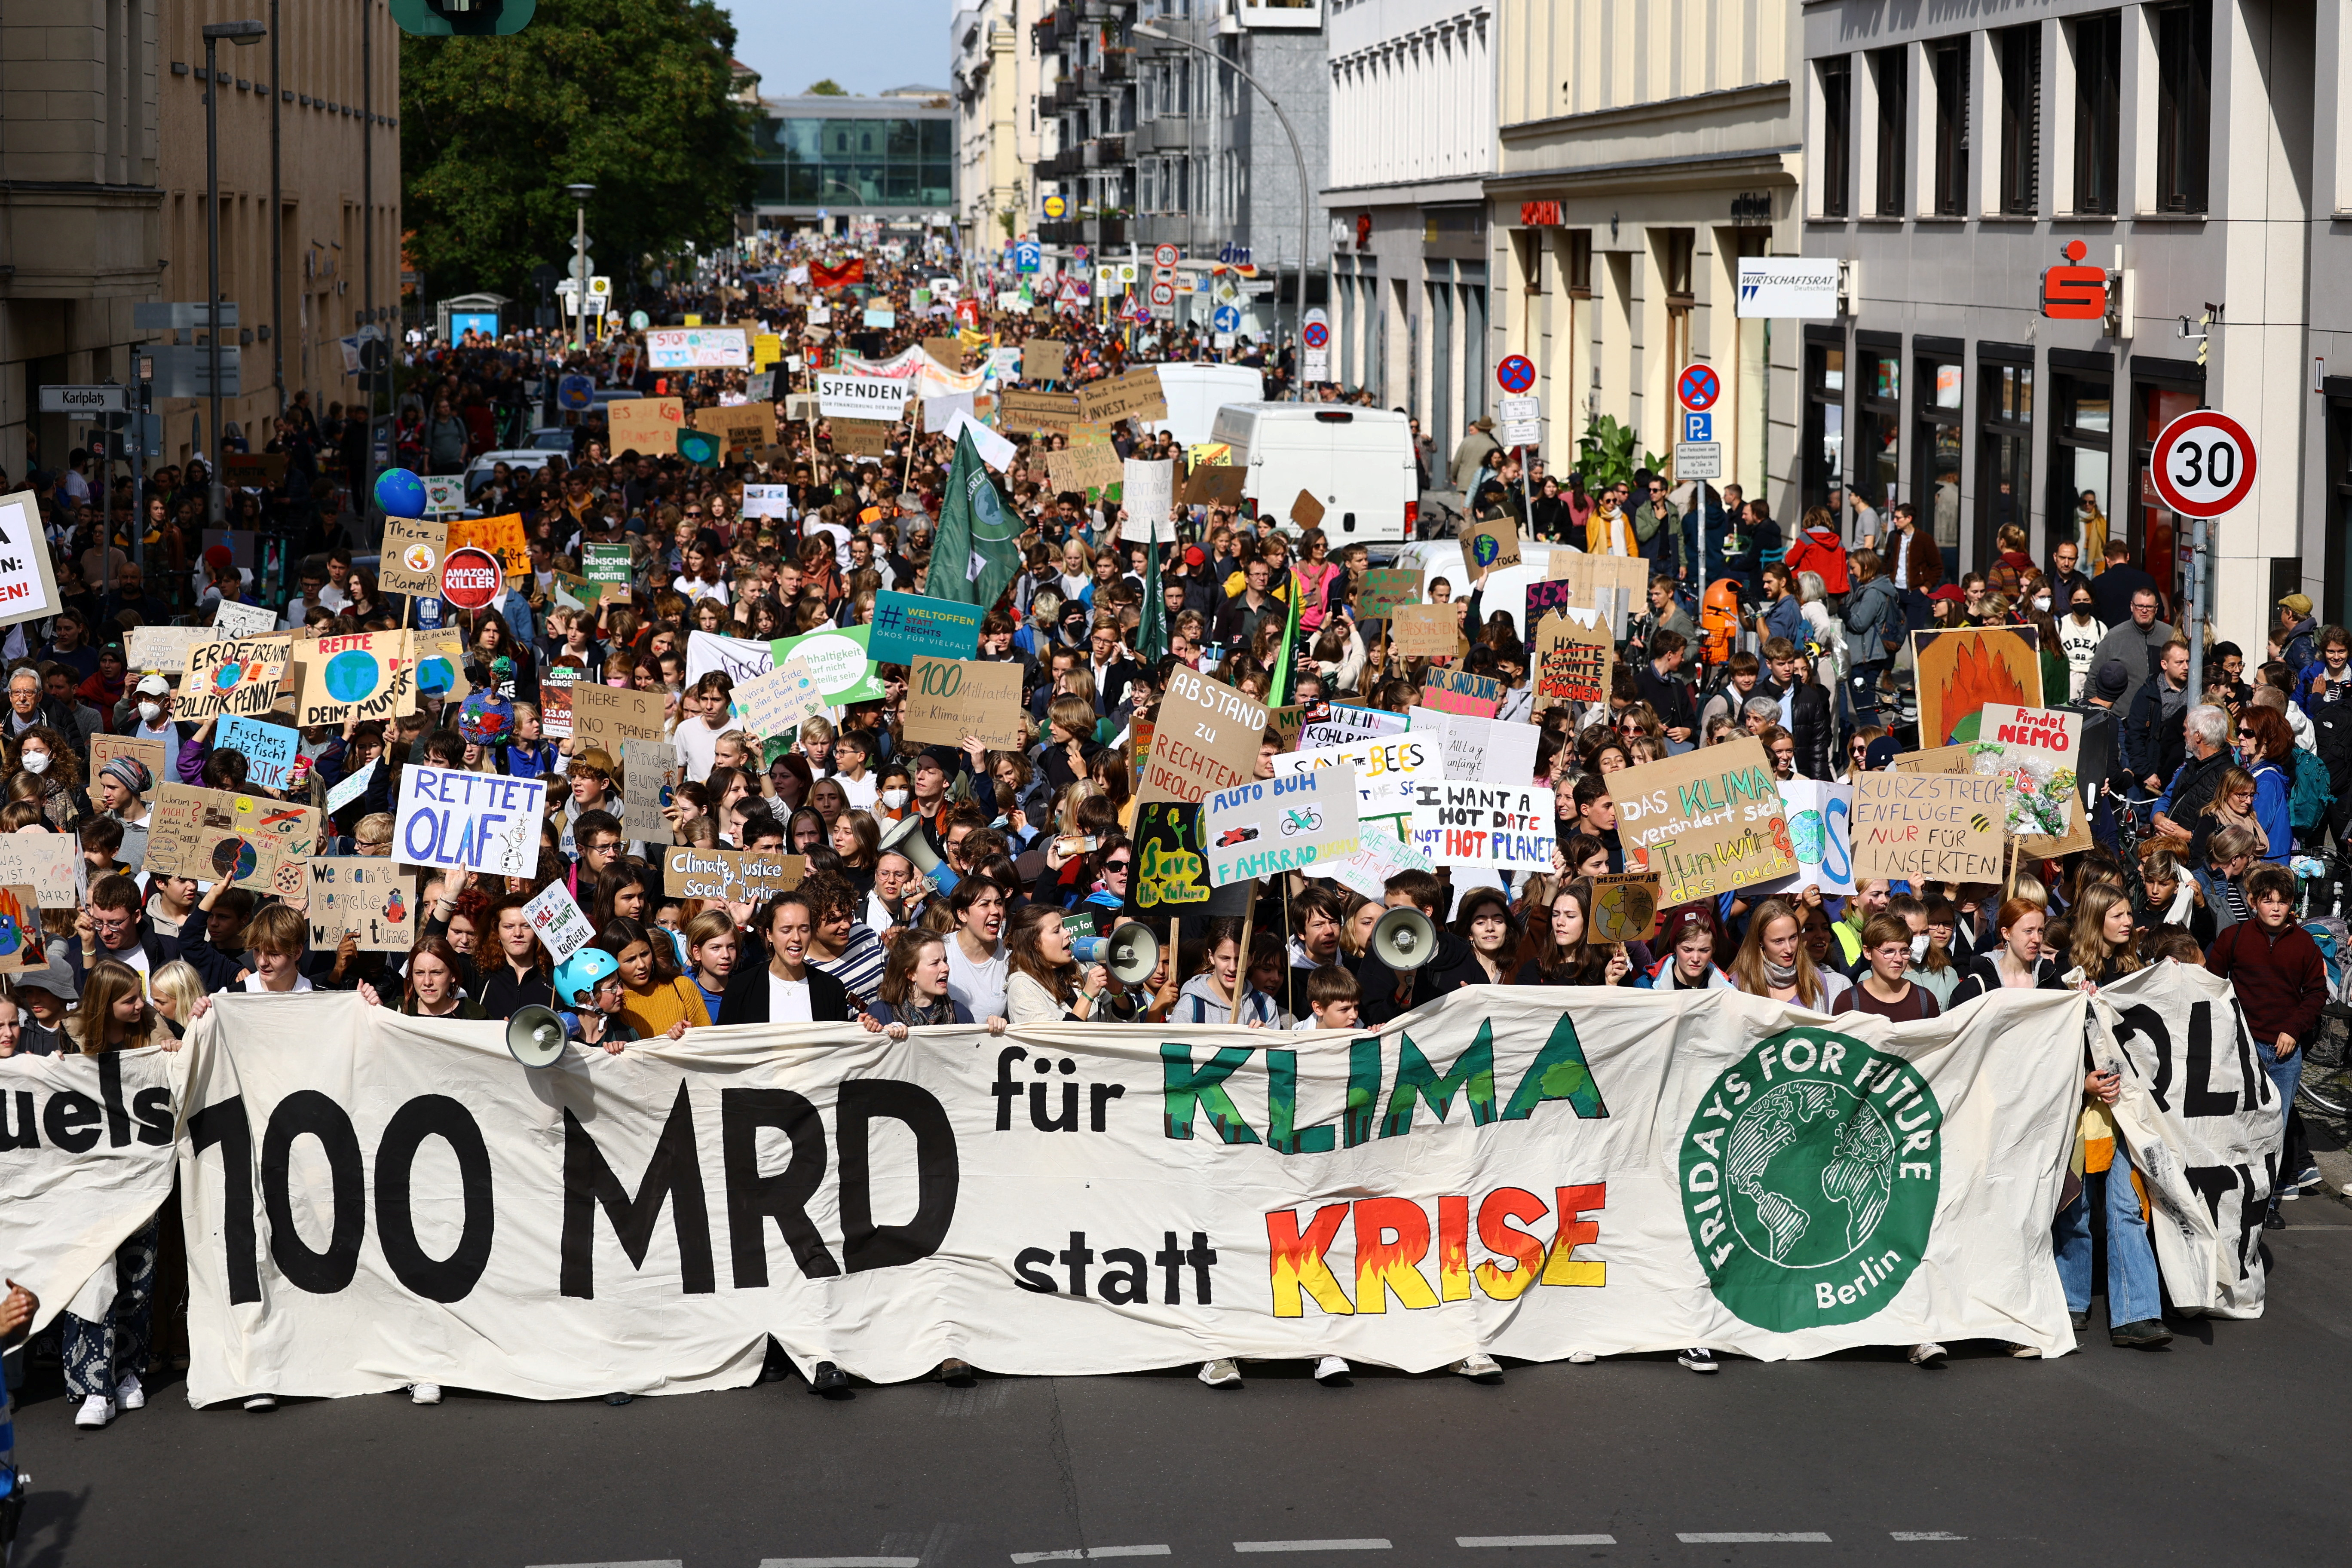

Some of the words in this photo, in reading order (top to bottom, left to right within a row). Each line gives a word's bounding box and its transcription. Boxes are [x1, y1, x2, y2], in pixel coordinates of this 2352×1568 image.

[1161, 251, 1173, 261] 30
[1742, 276, 1834, 285] WIRTSCHAFTSRAT
[657, 332, 686, 347] STOP
[822, 381, 902, 400] SPENDEN
[1089, 399, 1126, 420] INVEST
[1690, 416, 1704, 438] P
[1073, 443, 1112, 459] CLIMATE
[2175, 441, 2235, 489] 30
[389, 521, 429, 539] There
[435, 531, 444, 541] is
[1496, 553, 1520, 567] TOCK
[446, 568, 493, 577] AMAZON
[446, 577, 495, 589] KILLER
[588, 572, 625, 580] PROFITE!
[1528, 581, 1569, 609] SEX
[906, 617, 934, 627] STATT
[907, 607, 974, 626] WELTOFFEN
[1397, 610, 1410, 621] Mit
[877, 629, 903, 639] ÖKOS
[907, 634, 924, 643] FÜR
[929, 638, 971, 650] VIELFALT
[904, 626, 941, 637] RECHTS
[1400, 622, 1457, 635] ABSCHALTEN
[319, 634, 373, 654] RETTE
[1554, 636, 1605, 661] HÄTTE
[192, 642, 255, 671] ERDE
[826, 662, 846, 671] nicht
[1541, 651, 1605, 676] KÖNNTE
[739, 686, 765, 701] Wäre
[768, 679, 781, 690] die
[781, 668, 802, 684] Erde
[840, 672, 859, 680] sein.
[917, 662, 962, 698] 100
[957, 681, 1020, 701] Milliarden
[1427, 668, 1446, 689] WIR
[1446, 672, 1473, 695] SIND
[1471, 678, 1501, 701] JUNG
[579, 688, 620, 707] THERE
[634, 699, 646, 713] IS
[754, 696, 772, 710] eine
[774, 686, 793, 699] Bank
[1171, 673, 1267, 732] ABSTAND
[1538, 680, 1602, 702] MACHEN
[172, 691, 233, 720] POLITIK
[784, 699, 794, 710] sie
[908, 700, 927, 717] für
[930, 704, 959, 721] Klima
[962, 710, 985, 723] und
[544, 718, 570, 726] CLIMATE
[580, 717, 603, 733] NO
[614, 723, 660, 739] PLANET
[769, 711, 798, 734] gerettet
[2015, 708, 2066, 732] Findet
[230, 721, 285, 748] Fischers
[1997, 724, 2069, 752] NEMO
[254, 743, 286, 761] fischt
[626, 740, 677, 770] Ändert
[1155, 733, 1243, 790] RECHTEN
[1366, 743, 1424, 777] BEES
[1449, 740, 1483, 760] Alltag
[1447, 754, 1482, 775] anfängt
[413, 769, 544, 813] RETTET
[629, 772, 662, 790] eure
[1359, 784, 1393, 800] THE
[161, 792, 189, 806] Worum
[1212, 784, 1263, 815] AUTO
[1273, 772, 1317, 796] BUH
[1416, 786, 1442, 805] I
[1447, 786, 1510, 809] WANT
[1519, 794, 1530, 812] A
[1620, 790, 1669, 821] DAS
[1678, 765, 1776, 818] KLIMA
[161, 808, 188, 817] NICHT
[625, 811, 661, 830] politik
[1439, 807, 1484, 827] HOT
[1493, 811, 1540, 831] DATE
[1630, 810, 1735, 847] verändert
[1744, 794, 1782, 821] sich
[1858, 802, 1965, 823] ENFLÜGE
[404, 806, 507, 867] OLAF
[1415, 829, 1443, 843] NOT
[1446, 829, 1487, 858] HOT
[1491, 832, 1555, 862] PLANET
[1868, 824, 1919, 845] NUR
[1928, 829, 1966, 847] FÜR
[1360, 826, 1384, 851] SAVE
[1392, 841, 1436, 873] EARTH
[1423, 845, 1432, 858] A
[312, 864, 335, 883] We
[345, 867, 392, 883] can't
[671, 850, 730, 874] Climate
[735, 856, 783, 885] justice
[1217, 845, 1317, 885] FAHRRAD
[1652, 839, 1716, 886] Tun
[1873, 850, 1997, 876] INSEKTEN
[7, 869, 22, 880] IST
[1608, 875, 1623, 884] ZEIT
[1623, 873, 1645, 883] LÄUFT
[1645, 873, 1658, 884] AB
[1670, 877, 1715, 903] das
[1731, 846, 1792, 886] auch
[683, 879, 729, 899] Social
[318, 890, 380, 918] recycle
[532, 905, 554, 931] KOHLE
[548, 903, 576, 934] ZUKUNFT
[1080, 920, 1093, 929] for
[370, 919, 408, 944] time
[557, 925, 589, 957] KRAFTWERK
[991, 1045, 1126, 1133] für
[1159, 1011, 1610, 1156] KLIMA
[1688, 1073, 1751, 1272] FRIDAYS
[1758, 1037, 1847, 1080] FOR
[1853, 1057, 1933, 1181] FUTURE
[185, 1088, 495, 1306] 100
[559, 1077, 960, 1300] MRD
[1014, 1231, 1217, 1306] statt
[1265, 1181, 1607, 1319] KRISE
[1815, 1250, 1902, 1309] Berlin
